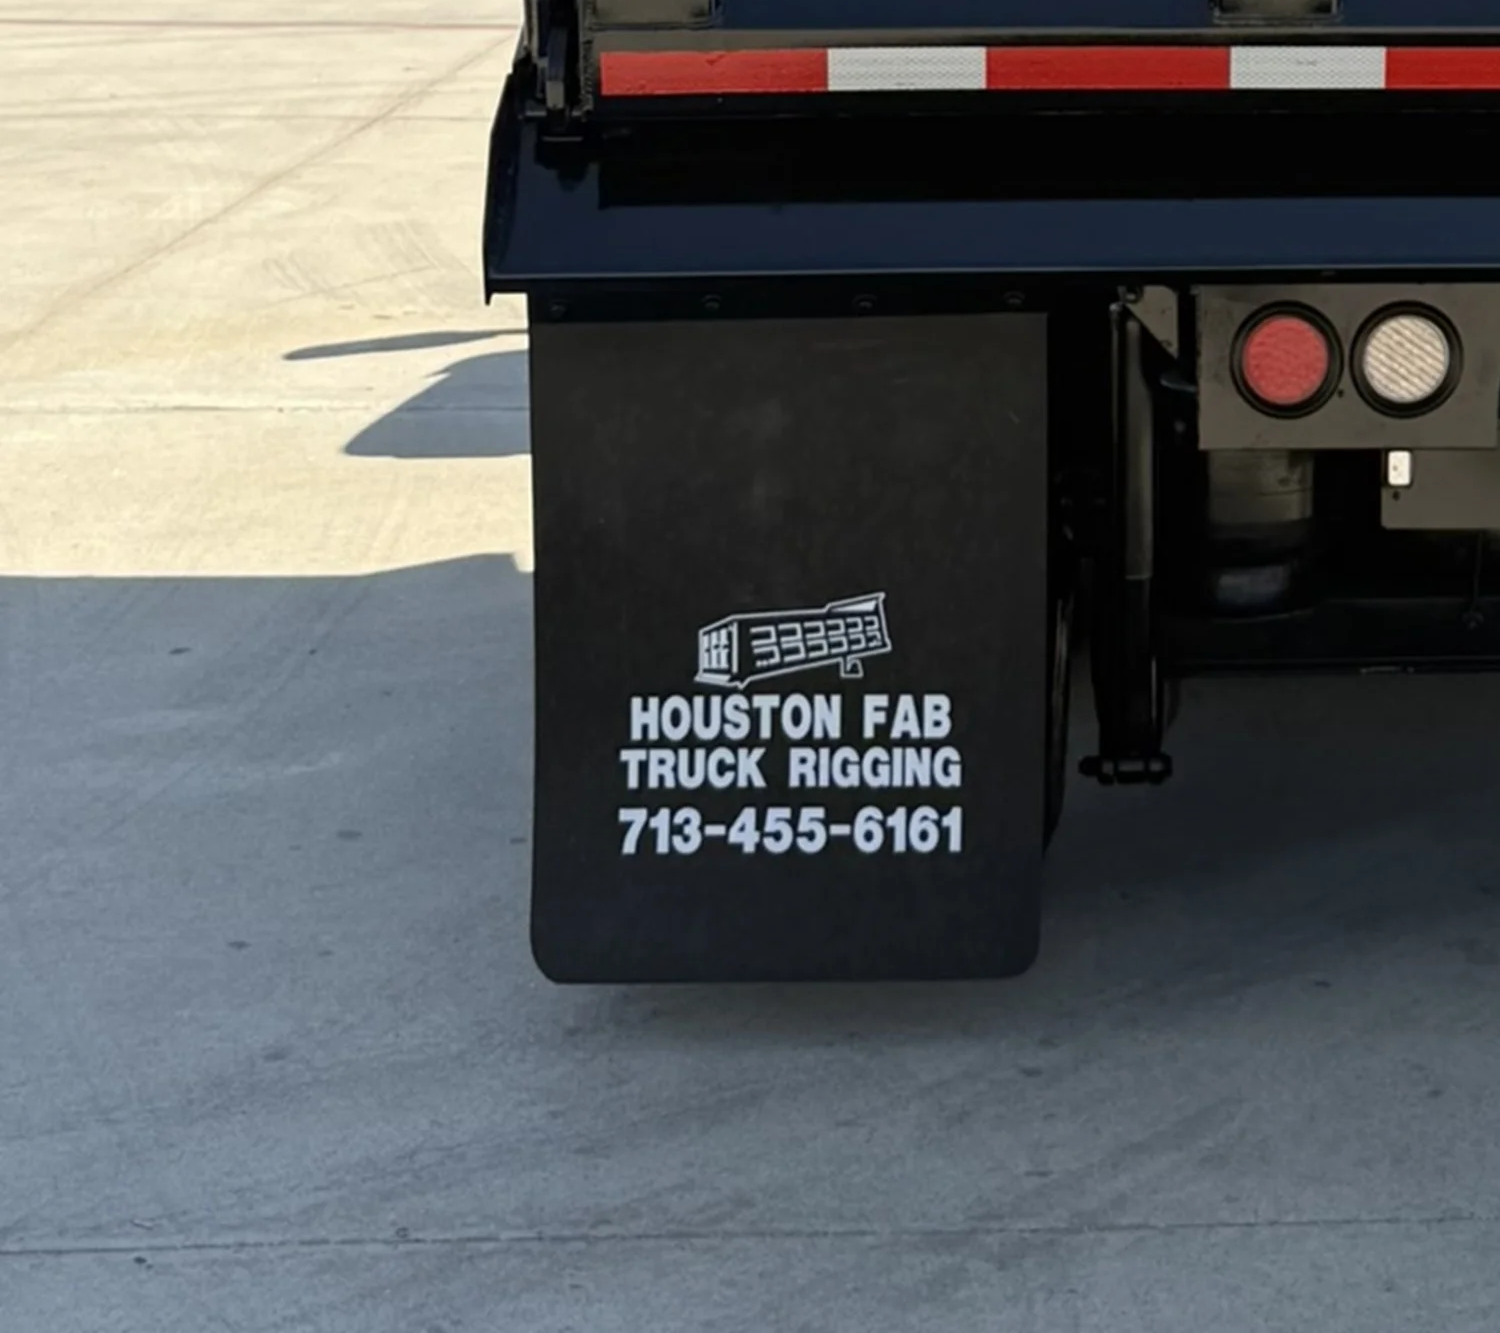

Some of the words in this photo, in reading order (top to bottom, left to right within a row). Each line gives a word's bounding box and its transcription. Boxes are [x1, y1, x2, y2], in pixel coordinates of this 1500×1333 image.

[629, 693, 842, 742] HOUSTON
[863, 693, 952, 740] FAB
[619, 747, 767, 790] TRUCK
[788, 746, 963, 789] RIGGING
[617, 805, 964, 855] 713-455-6161
